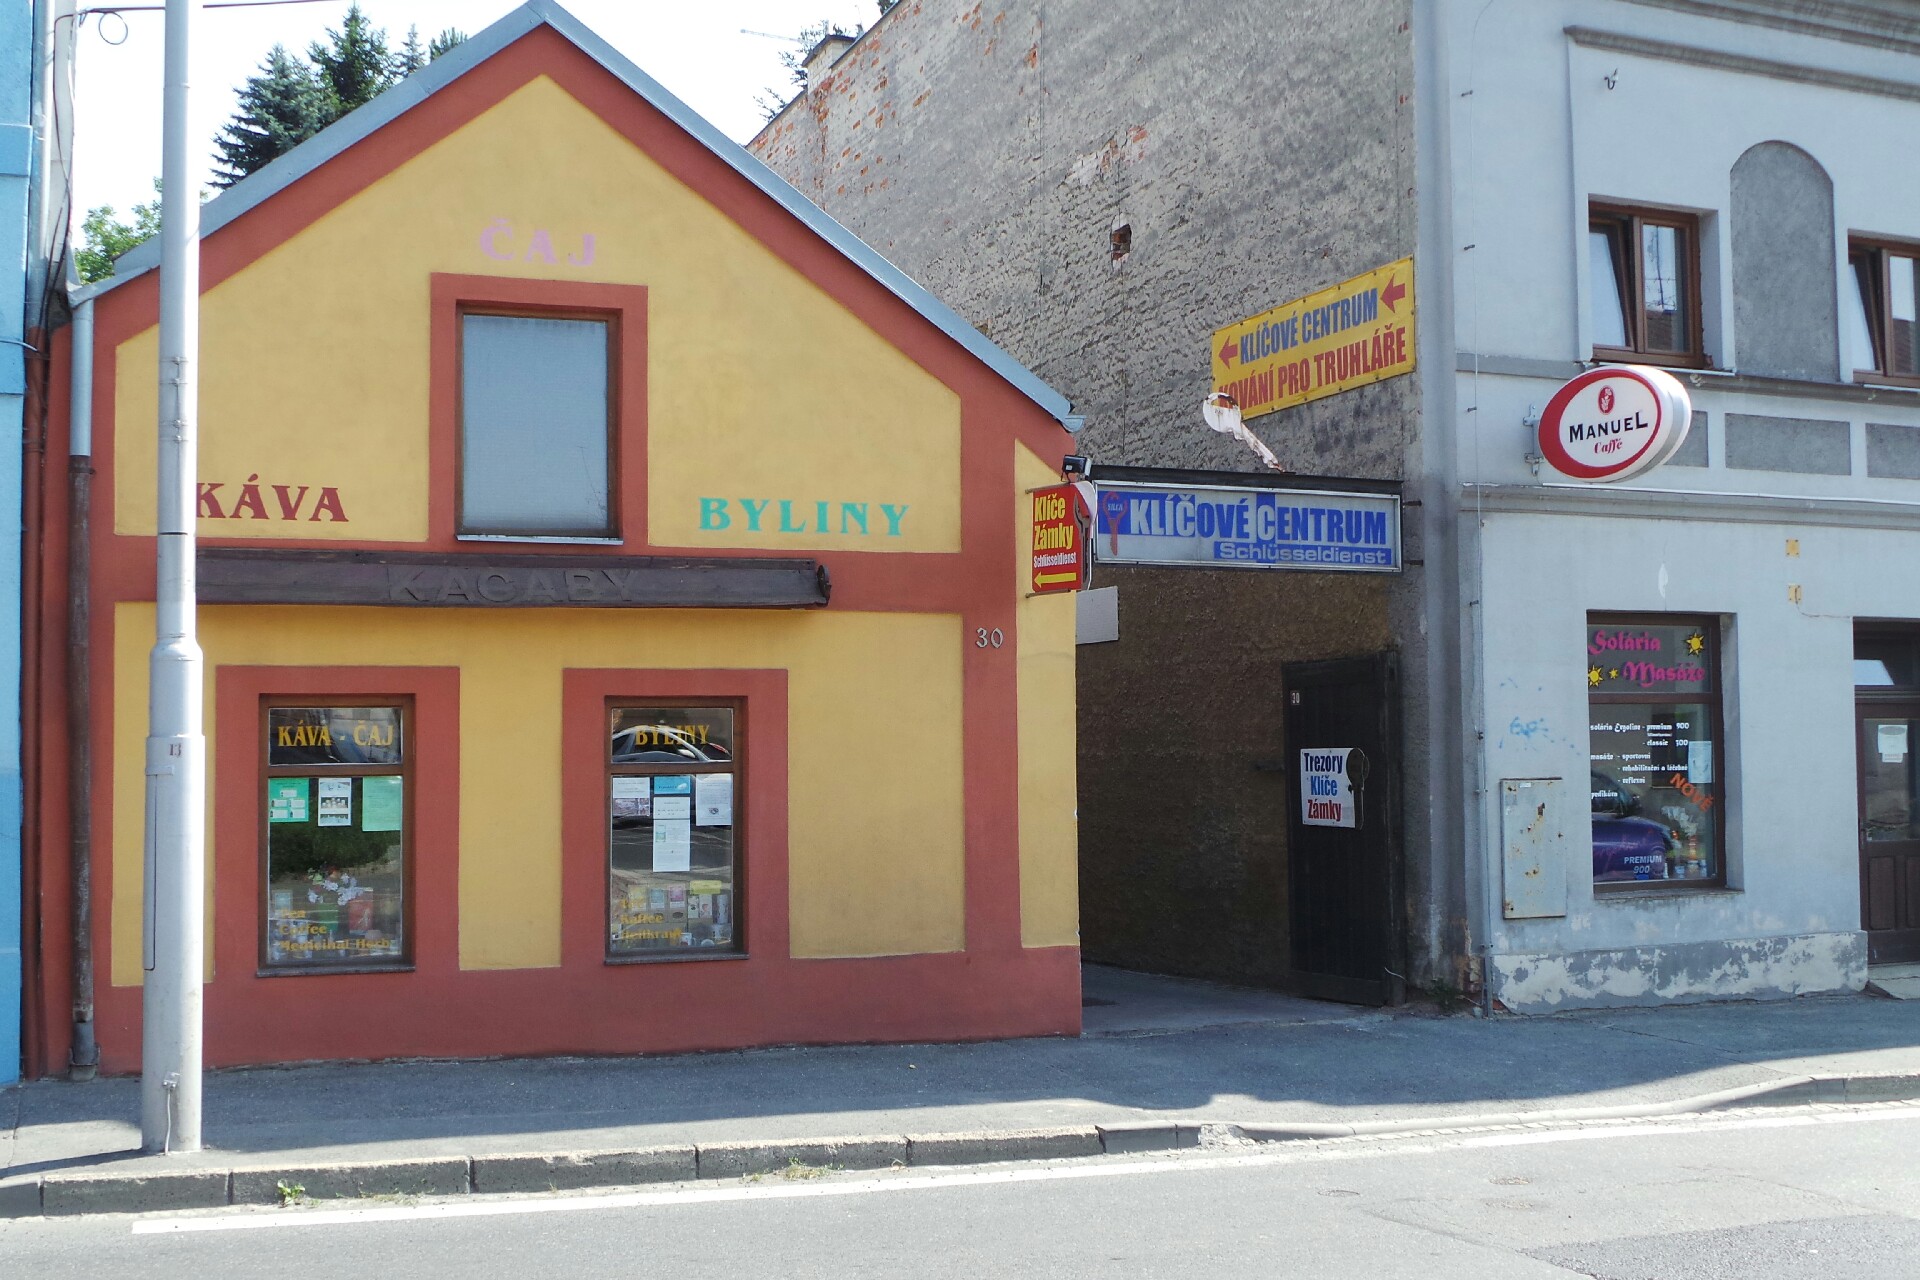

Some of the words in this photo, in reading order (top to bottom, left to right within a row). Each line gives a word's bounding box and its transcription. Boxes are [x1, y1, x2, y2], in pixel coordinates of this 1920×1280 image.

[478, 217, 598, 267] ČAJ
[1240, 310, 1299, 365] KLÍČOVÉ
[1301, 287, 1379, 344] CENTRUM
[1218, 363, 1275, 413] KOVÁNÍ
[1277, 357, 1311, 399] PRO
[1313, 322, 1408, 388] TRUHLÁŘE
[1569, 411, 1649, 443] MANUEL
[196, 473, 350, 523] KÁVA
[1034, 494, 1067, 523] Klíče
[697, 496, 911, 537] BYLINY
[1130, 493, 1250, 540] KLÍČOVÉ
[1257, 504, 1387, 545] CENTRUM
[1033, 522, 1074, 551] Zámky
[1033, 551, 1078, 569] Schlüsseldienst
[1220, 542, 1387, 565] Schlüsseldienst
[976, 627, 1004, 649] 30
[1588, 629, 1662, 655] Solária
[1622, 661, 1706, 688] Masáže
[1292, 692, 1300, 704] 30
[277, 719, 332, 747] KÁVA
[353, 720, 394, 746] ČAJ
[635, 724, 710, 746] BYLINY
[1304, 752, 1343, 774] Trezory
[1310, 775, 1338, 797] Klíče
[1307, 799, 1342, 822] Zámky
